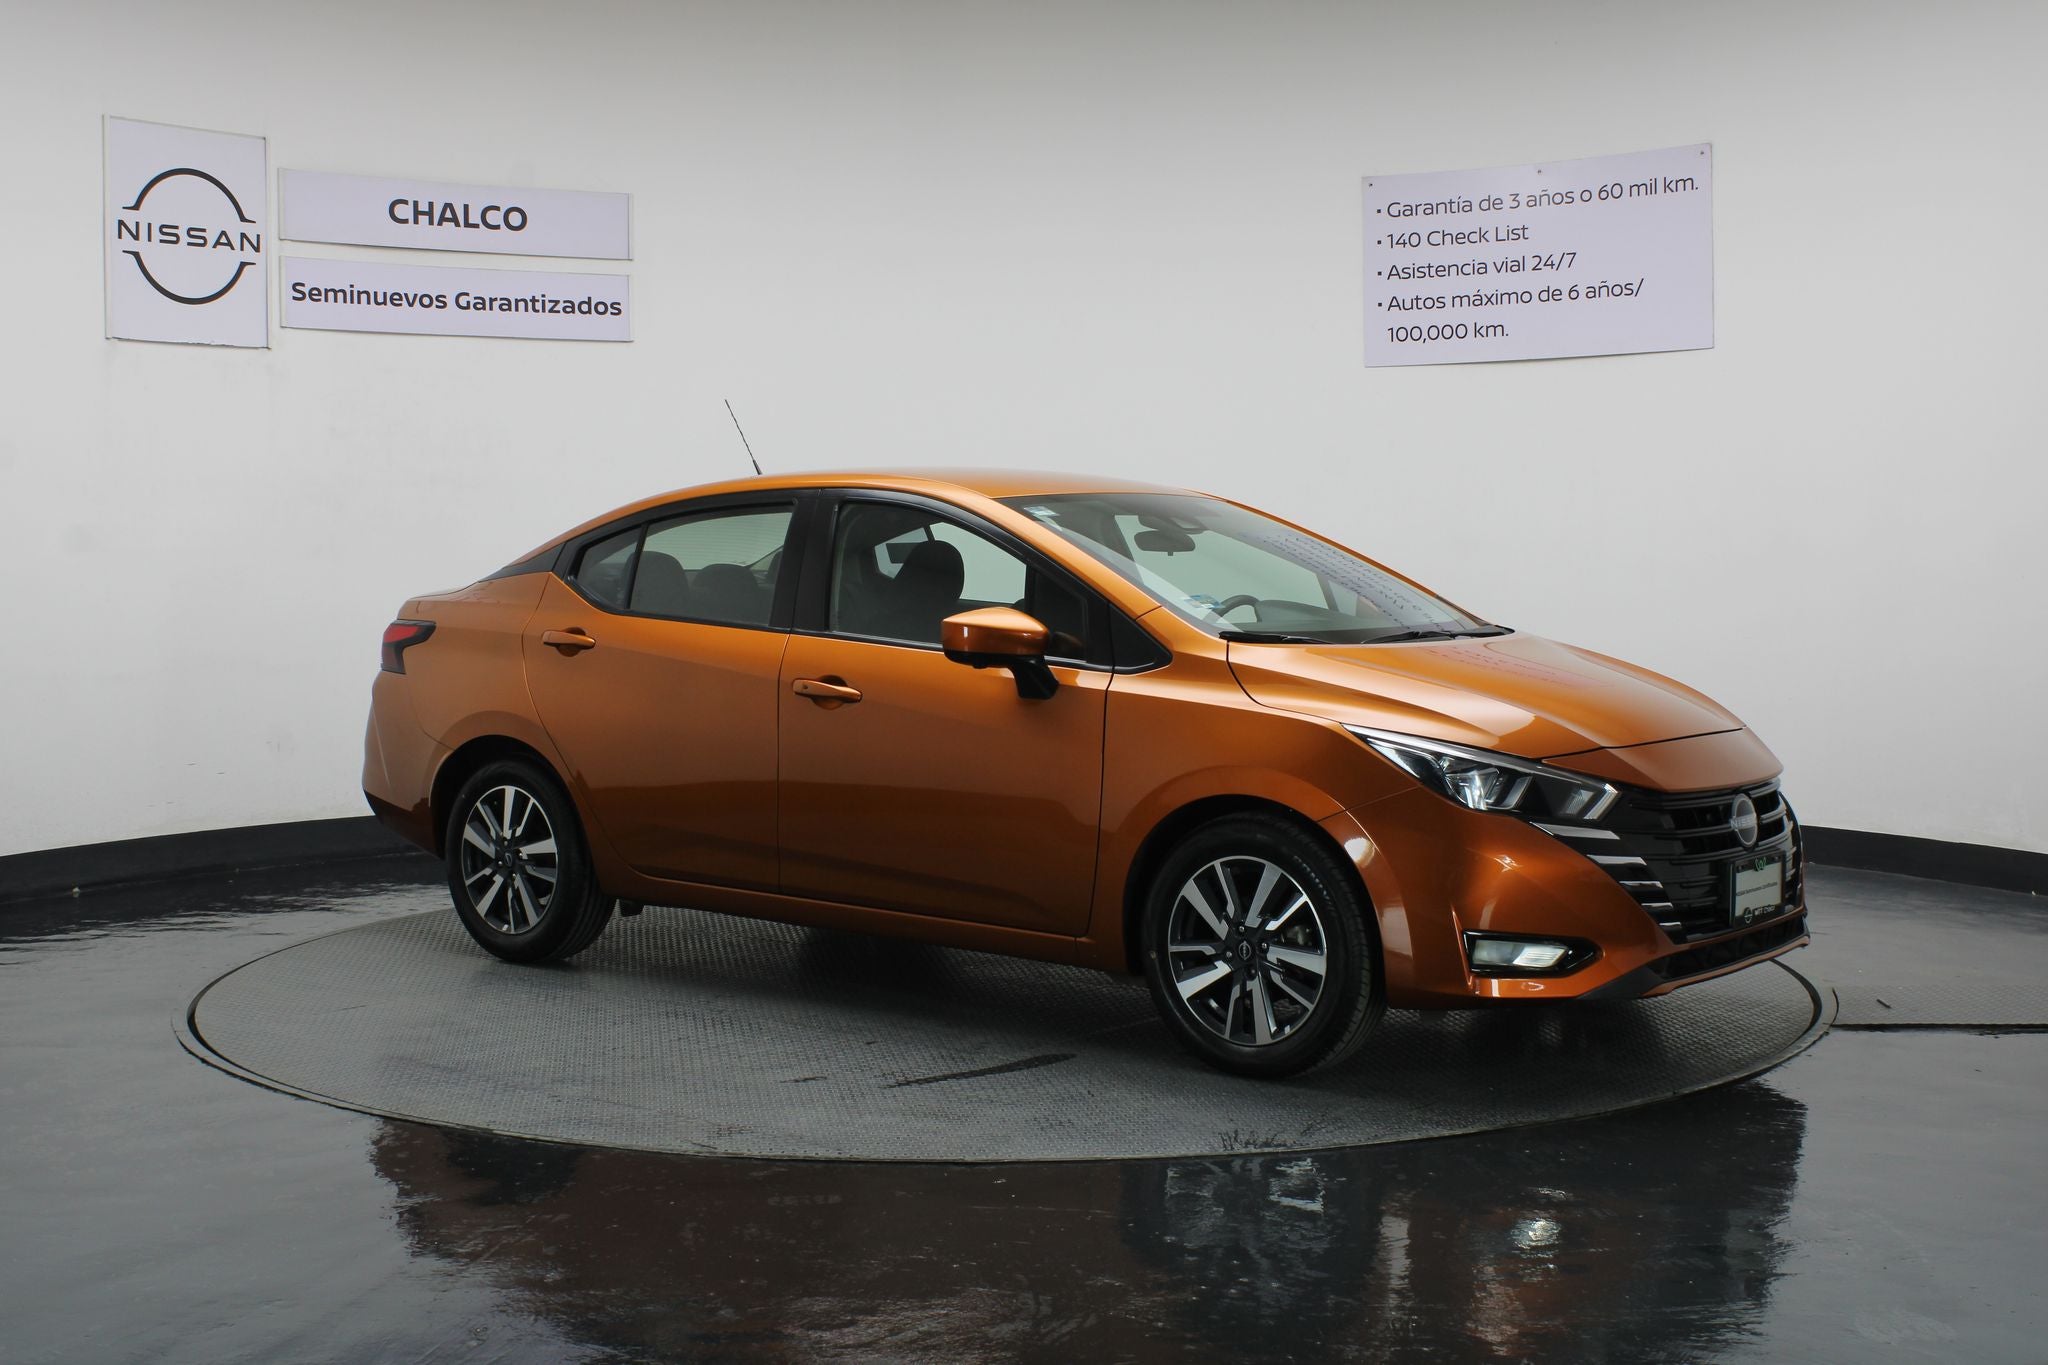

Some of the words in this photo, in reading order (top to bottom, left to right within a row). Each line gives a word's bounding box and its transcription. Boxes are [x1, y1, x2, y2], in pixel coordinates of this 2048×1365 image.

[1386, 195, 1473, 218] Garantía
[1478, 194, 1504, 212] de
[1509, 192, 1521, 210] 3
[1526, 189, 1575, 208] años
[1579, 189, 1593, 203] o
[1597, 182, 1624, 201] 60
[1629, 177, 1658, 198] mil
[1663, 176, 1699, 196] km.
[388, 198, 528, 232] CHALCO
[117, 219, 261, 254] NISSAN
[1386, 233, 1422, 249] 140
[1426, 226, 1490, 247] Check
[1495, 224, 1529, 244] List
[1386, 258, 1488, 281] Asistencia
[1493, 256, 1526, 274] vial
[1531, 251, 1577, 272] 24/7
[291, 281, 448, 312] Seminuevos
[454, 291, 623, 317] Garantizados
[1387, 294, 1447, 312] Autos
[1451, 288, 1533, 310] máximo
[1537, 285, 1563, 303] de
[1567, 283, 1580, 301] 6
[1585, 277, 1645, 300] años/
[1387, 323, 1469, 344] 100,000
[1473, 321, 1510, 339] km.
